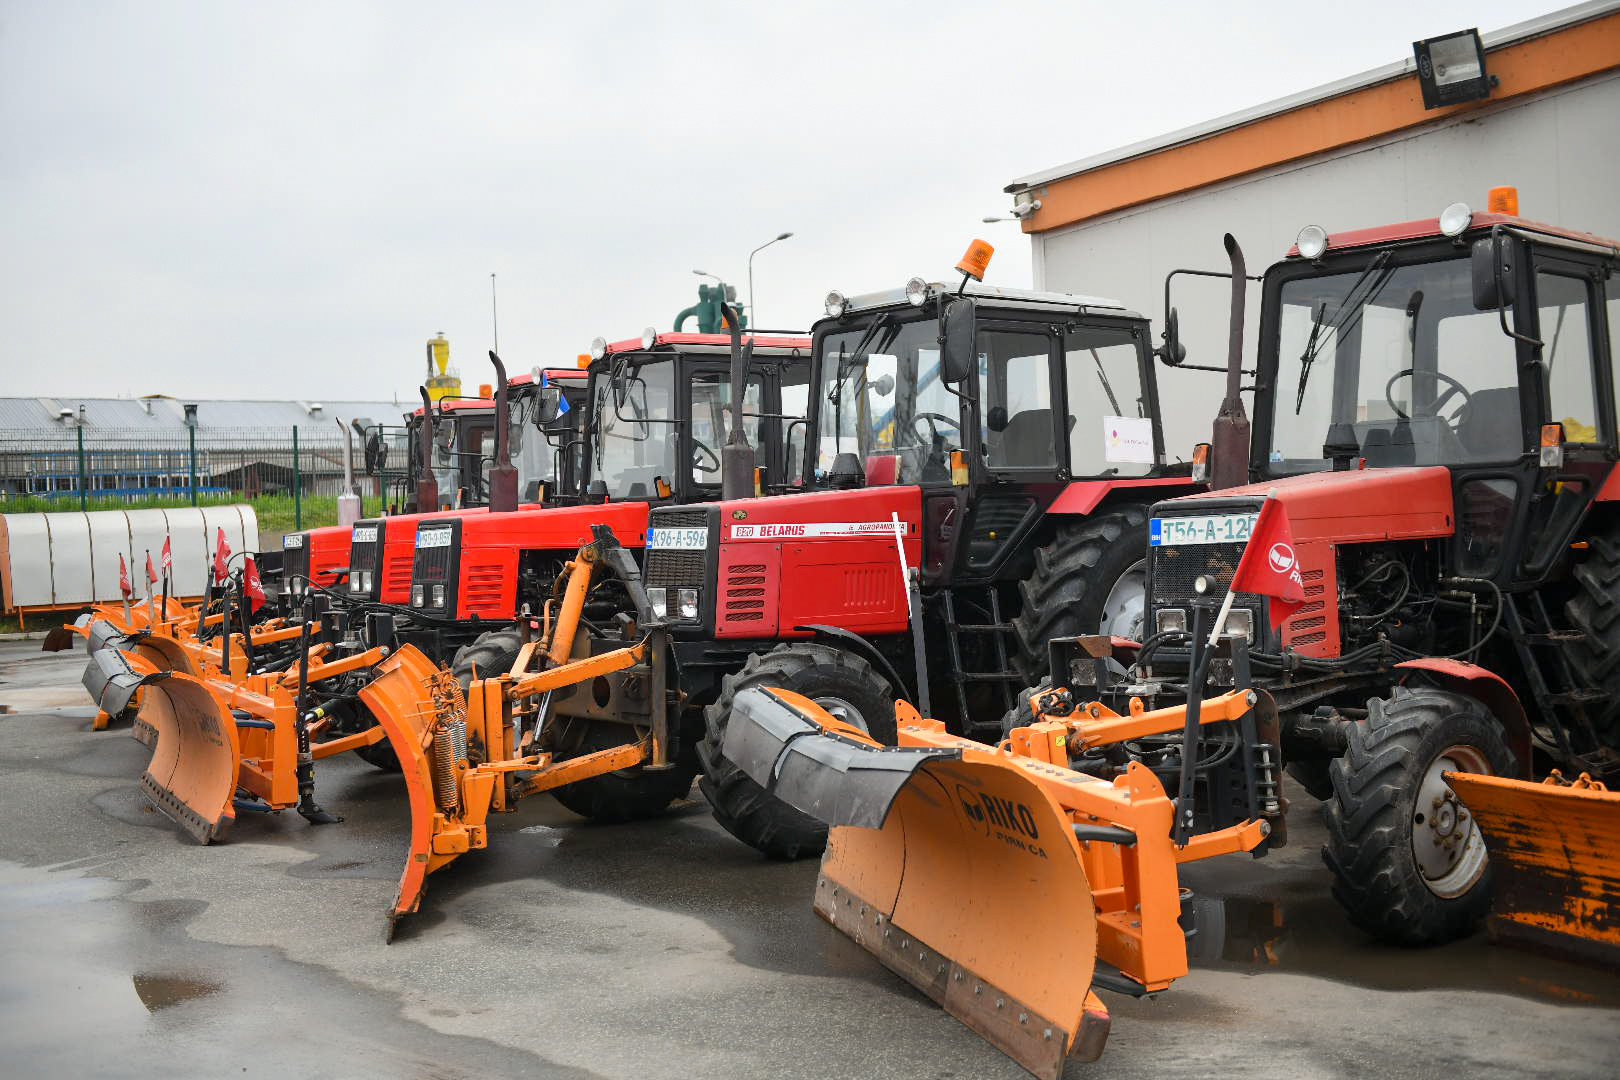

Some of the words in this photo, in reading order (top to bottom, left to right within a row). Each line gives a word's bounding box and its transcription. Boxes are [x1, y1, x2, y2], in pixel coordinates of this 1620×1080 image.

[654, 530, 705, 547] K96-A-596
[736, 526, 754, 537] 820
[760, 524, 806, 537] BELARUS
[978, 792, 1038, 840] RIKO
